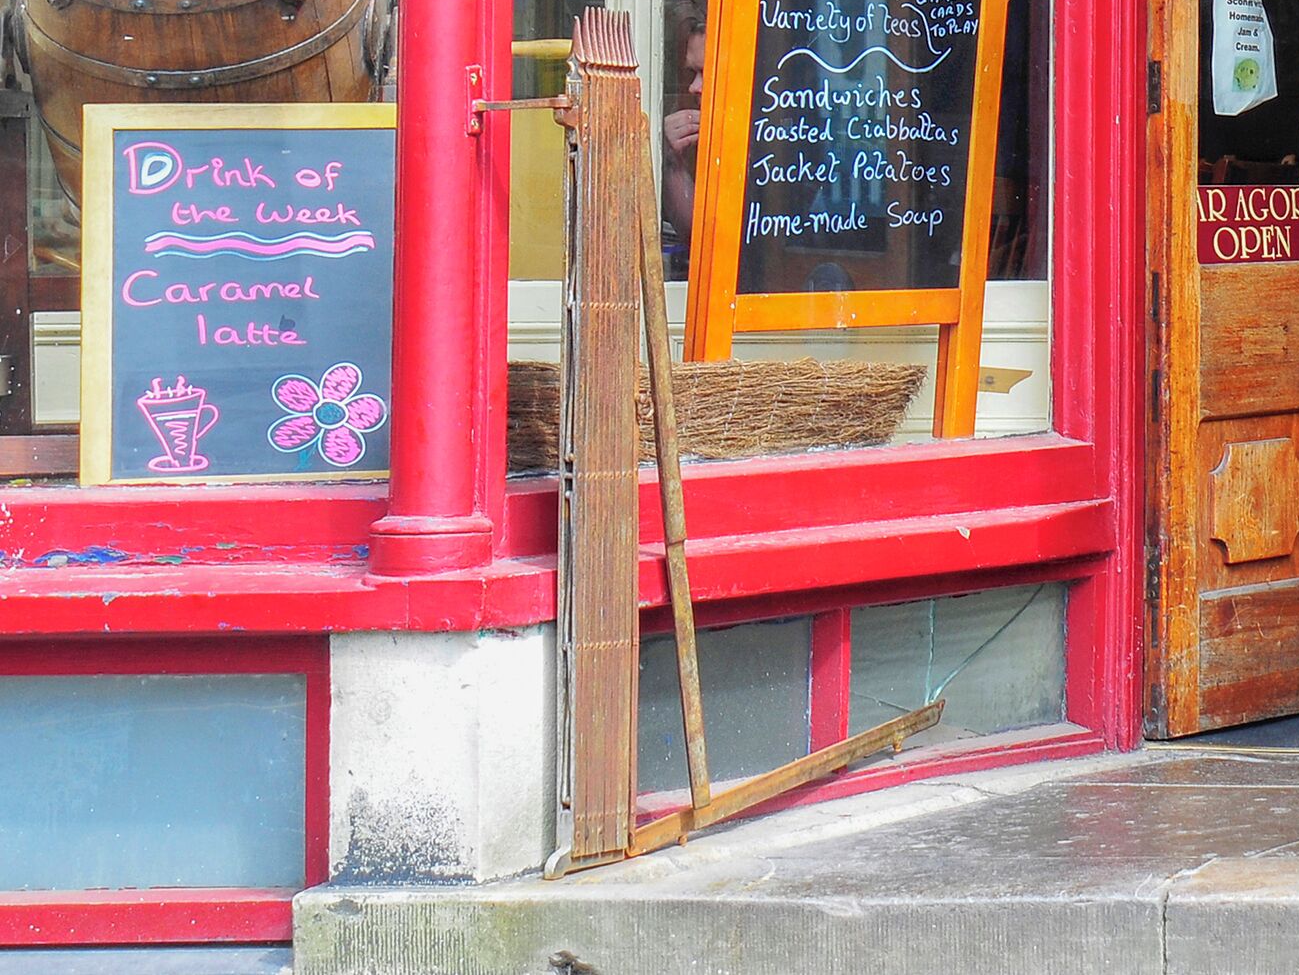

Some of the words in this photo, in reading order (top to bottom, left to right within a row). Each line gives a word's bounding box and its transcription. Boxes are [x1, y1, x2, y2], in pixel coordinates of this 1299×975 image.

[760, 0, 851, 44] Variety
[856, 2, 876, 33] of
[878, 2, 922, 38] teas
[930, 2, 974, 20] CARDS
[930, 22, 946, 38] TO
[945, 17, 979, 36] PLAY
[761, 74, 922, 113] Sandwiches
[754, 116, 834, 145] Toasted
[123, 141, 277, 195] Drink
[294, 161, 344, 192] of
[752, 151, 842, 187] Jacket
[852, 150, 952, 187] Potatoes
[171, 200, 240, 226] the
[886, 200, 944, 238] Soup
[1213, 224, 1292, 261] OPEN
[121, 269, 321, 308] Caramel
